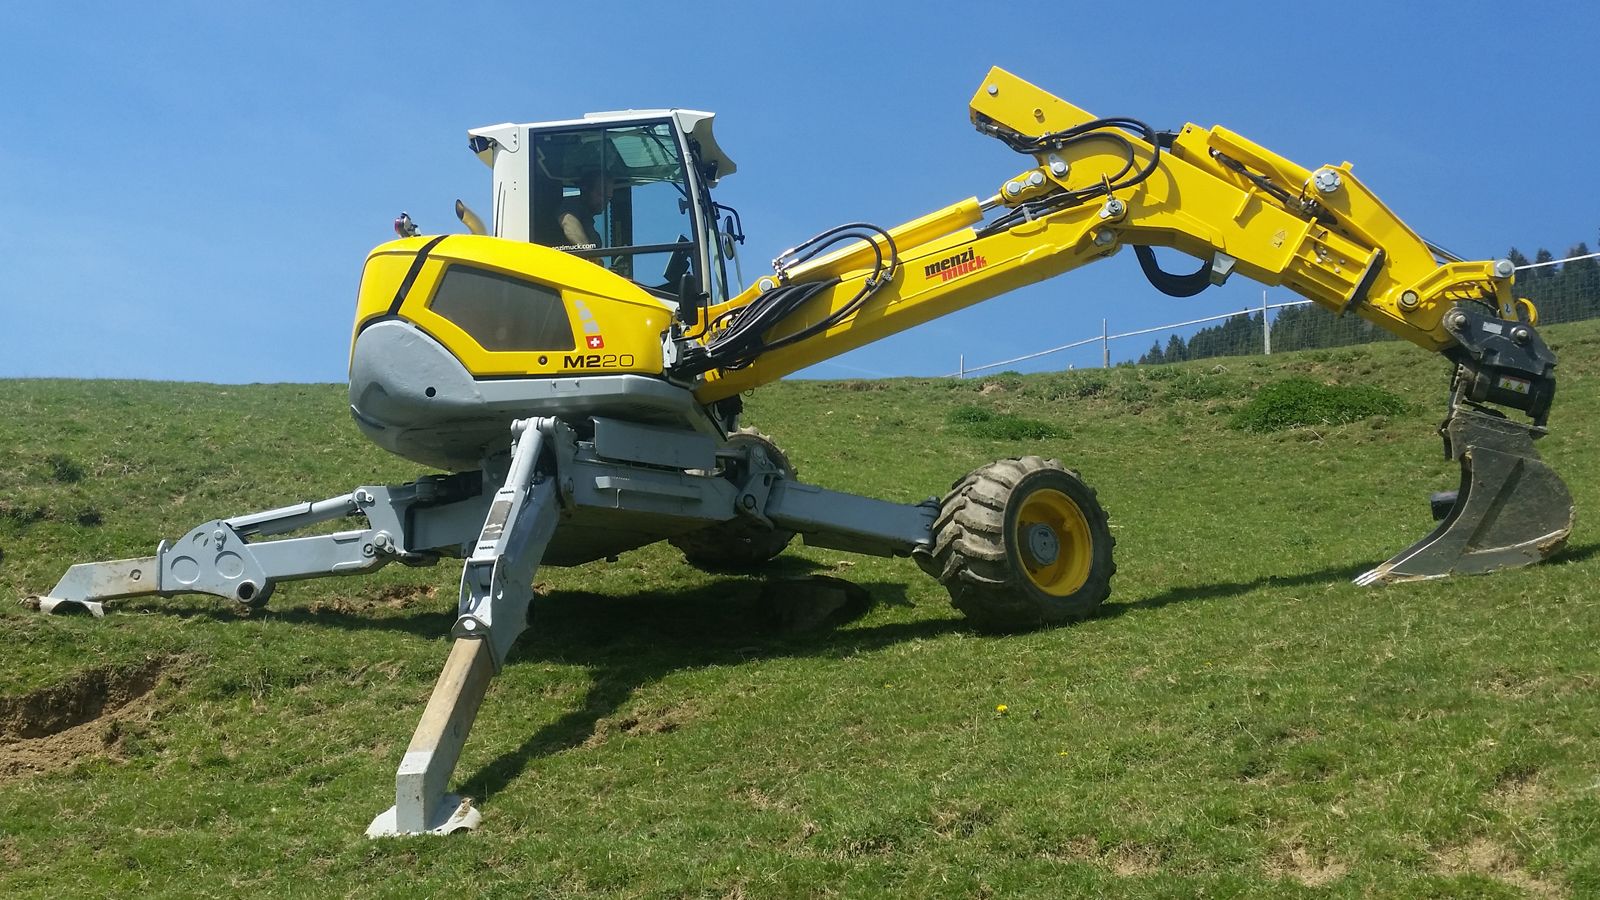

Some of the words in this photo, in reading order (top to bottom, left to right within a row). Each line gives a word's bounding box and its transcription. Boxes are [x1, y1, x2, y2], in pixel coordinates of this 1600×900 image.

[924, 247, 975, 277] menzi
[941, 255, 988, 282] muck
[563, 354, 635, 369] M220
